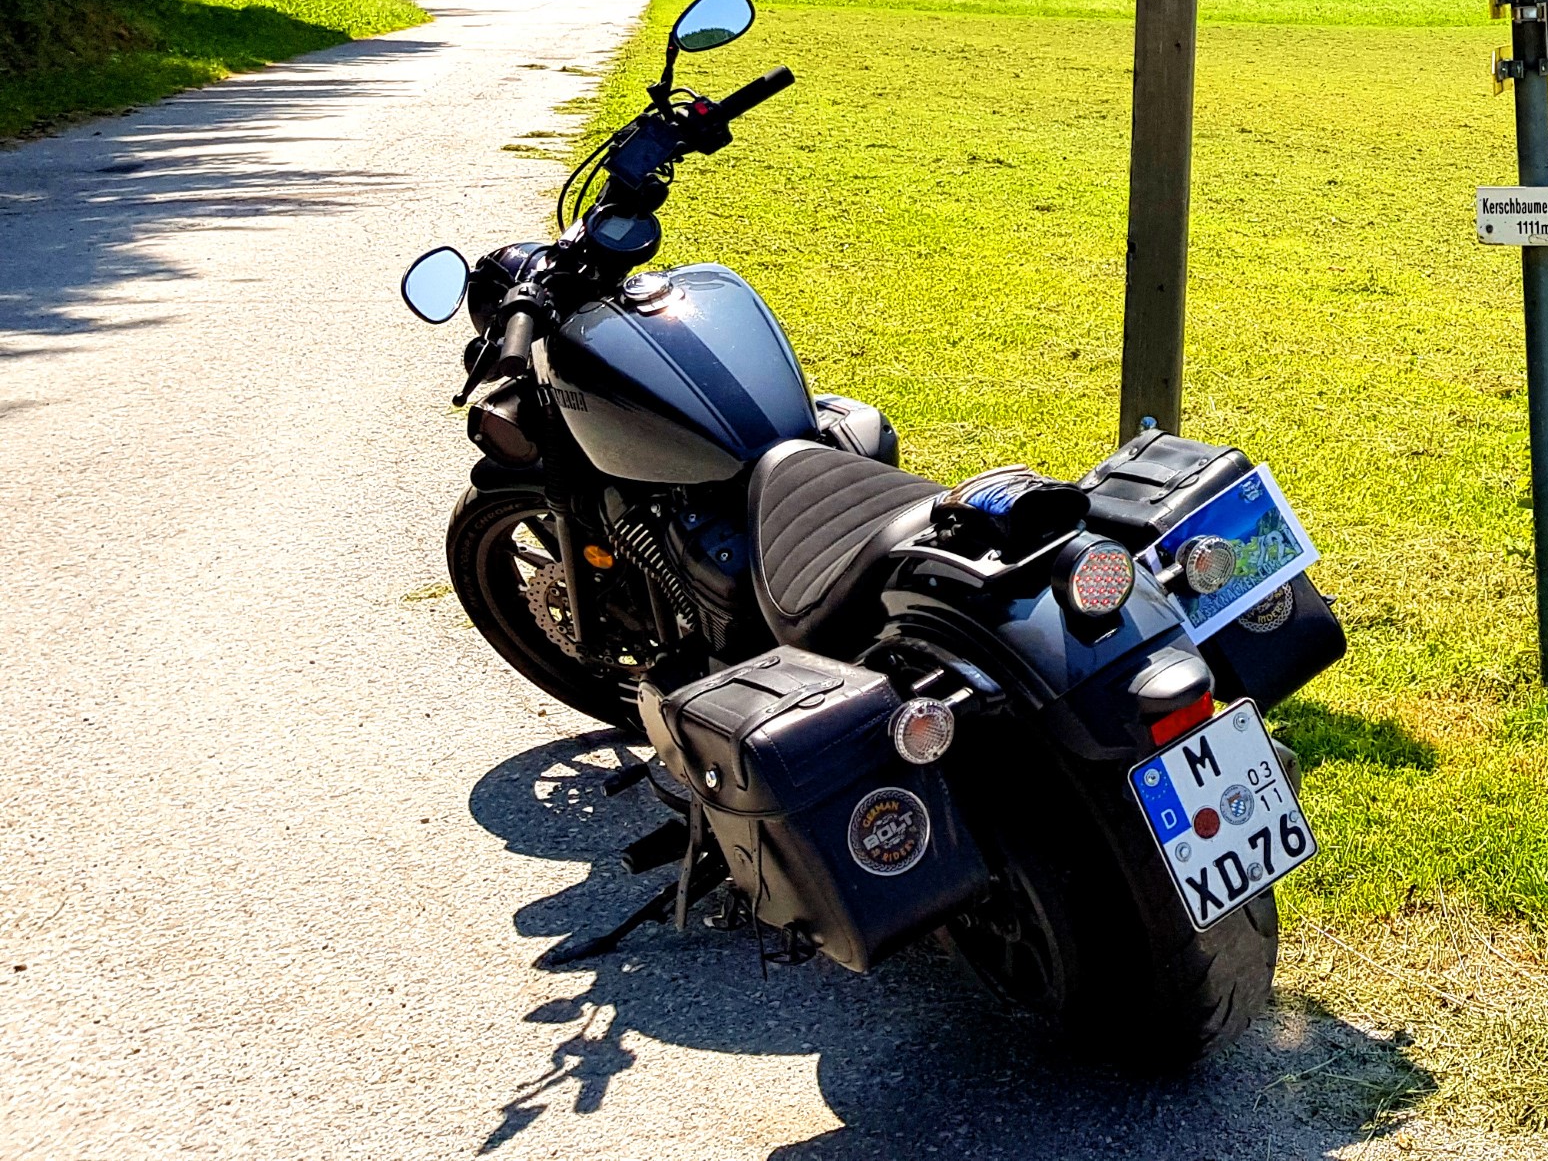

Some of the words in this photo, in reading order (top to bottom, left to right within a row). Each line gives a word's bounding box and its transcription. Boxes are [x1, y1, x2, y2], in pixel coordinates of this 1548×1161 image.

[1182, 735, 1222, 788] M
[862, 810, 914, 851] BOLT
[1160, 808, 1179, 830] D
